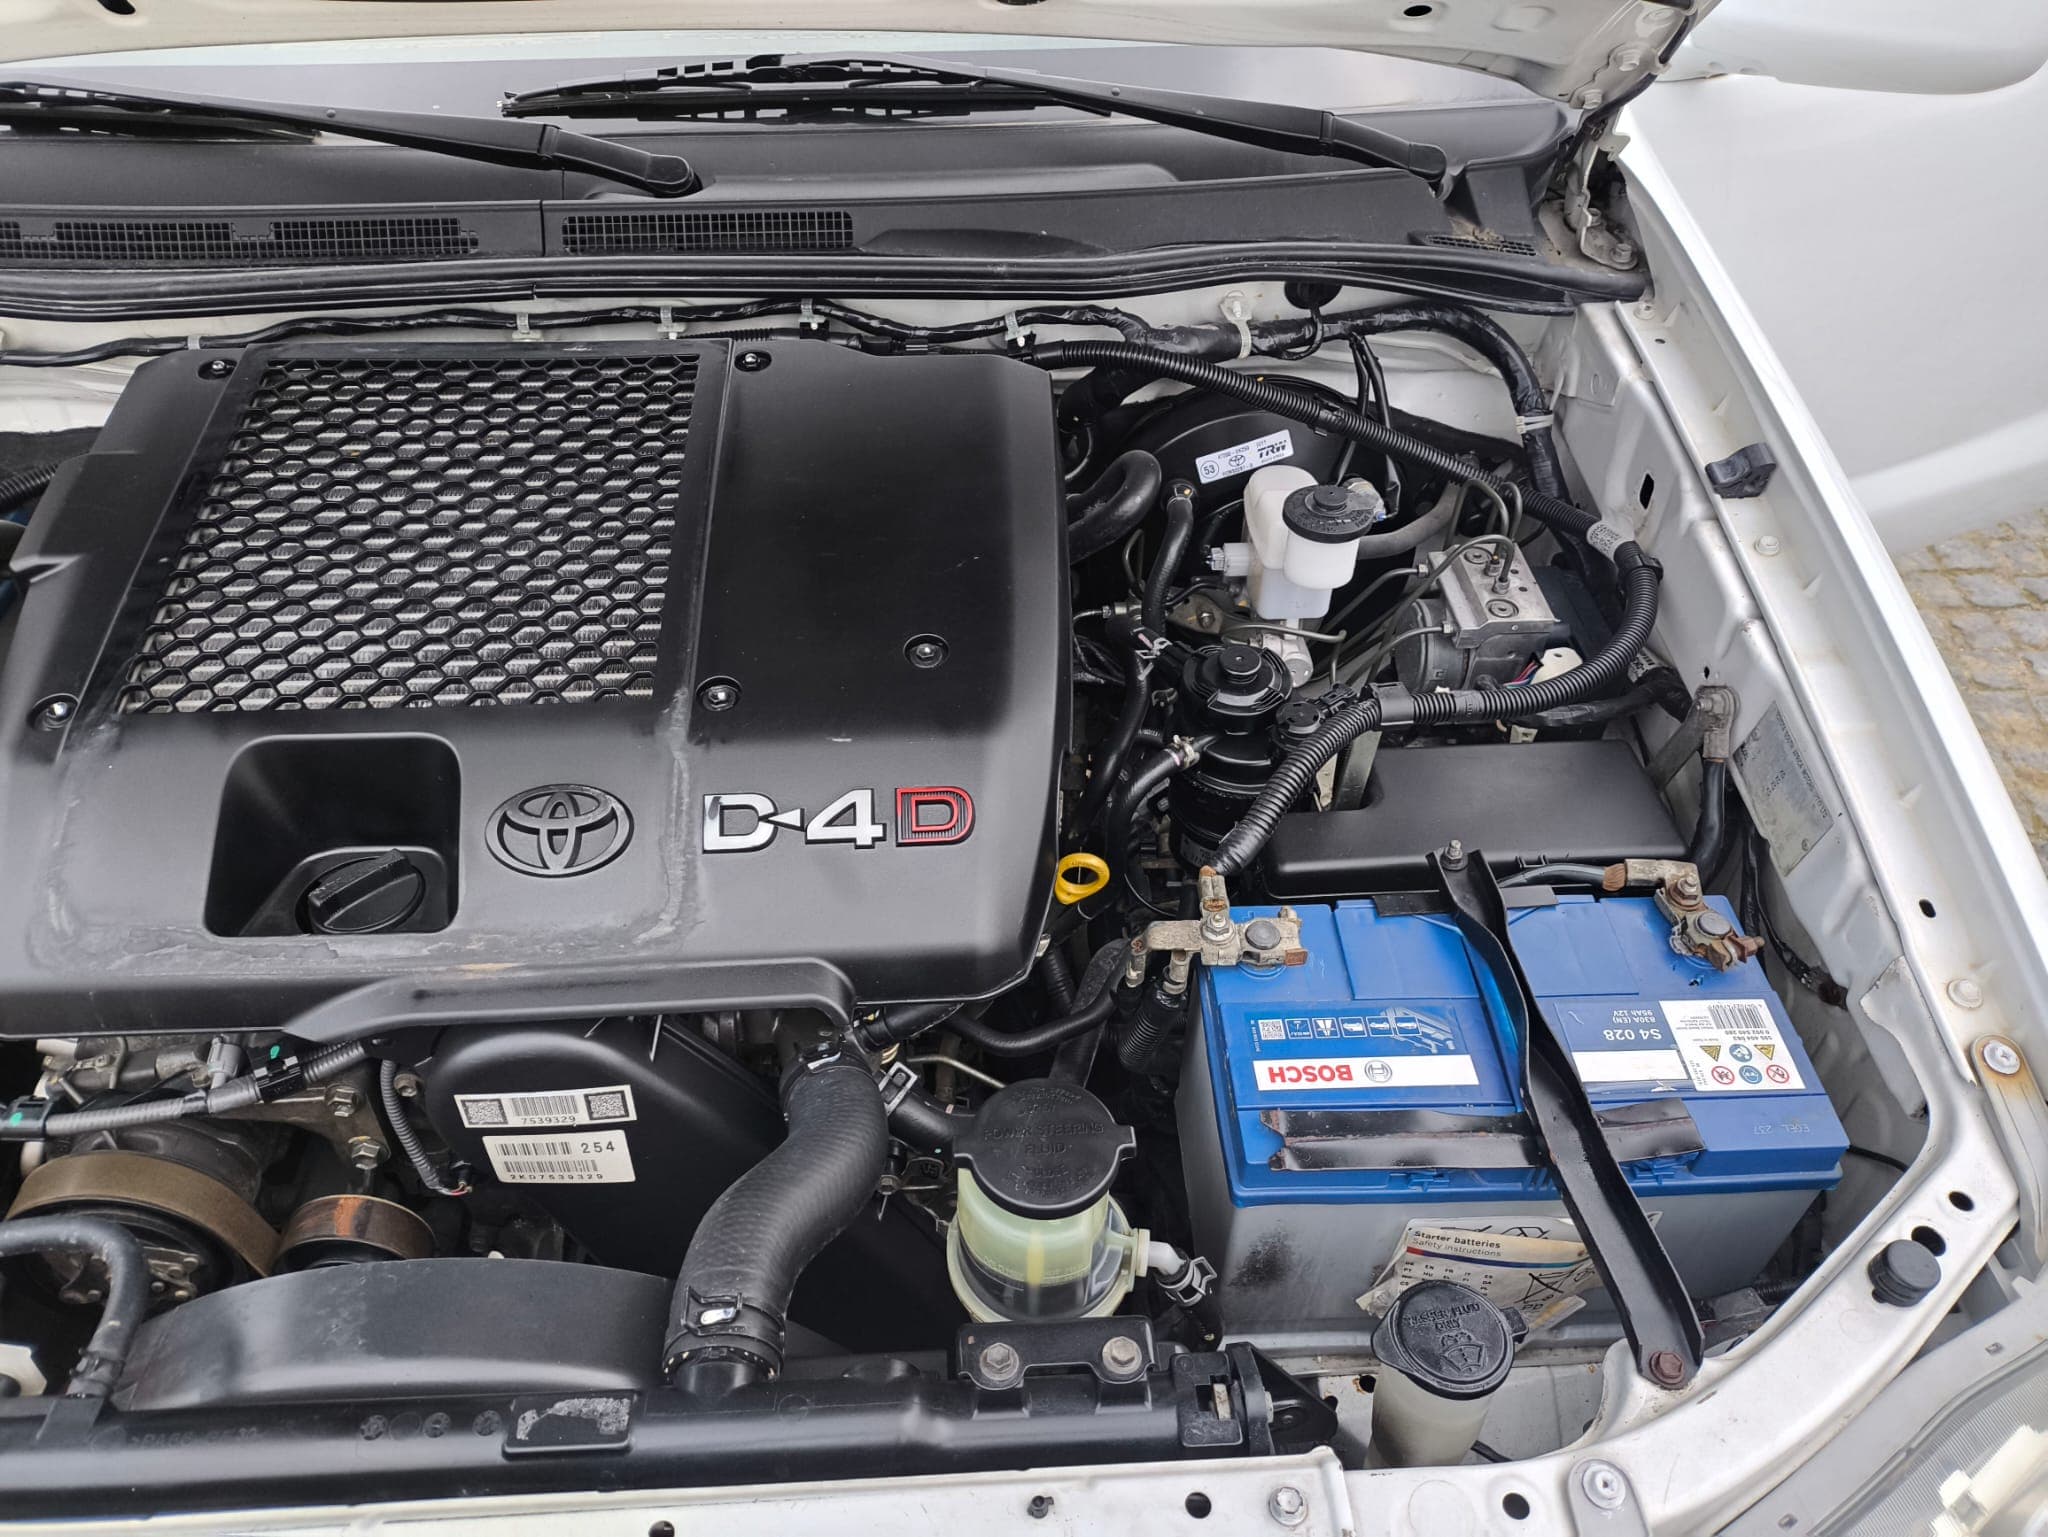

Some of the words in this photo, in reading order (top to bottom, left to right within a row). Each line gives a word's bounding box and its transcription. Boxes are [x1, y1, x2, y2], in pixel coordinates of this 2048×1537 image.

[1257, 440, 1287, 458] TRW
[1203, 464, 1216, 476] 53
[1613, 1009, 1629, 1017] 12V
[1631, 1009, 1654, 1017] 95Ah
[1612, 1016, 1632, 1025] (EN)
[1633, 1016, 1656, 1024] 830A
[1603, 1029, 1636, 1041] 028
[1639, 1028, 1663, 1041] S4
[1268, 1064, 1354, 1083] BOSCH
[520, 1115, 576, 1126] 7539329
[1037, 1122, 1105, 1137] STEERING
[580, 1141, 615, 1154] 254
[1025, 1143, 1067, 1154] FLUID
[1414, 1230, 1452, 1242] Starter
[1454, 1237, 1501, 1249] batteries
[1412, 1238, 1442, 1250] Safety
[1445, 1245, 1502, 1257] instructions
[1450, 1302, 1481, 1317] FLUID
